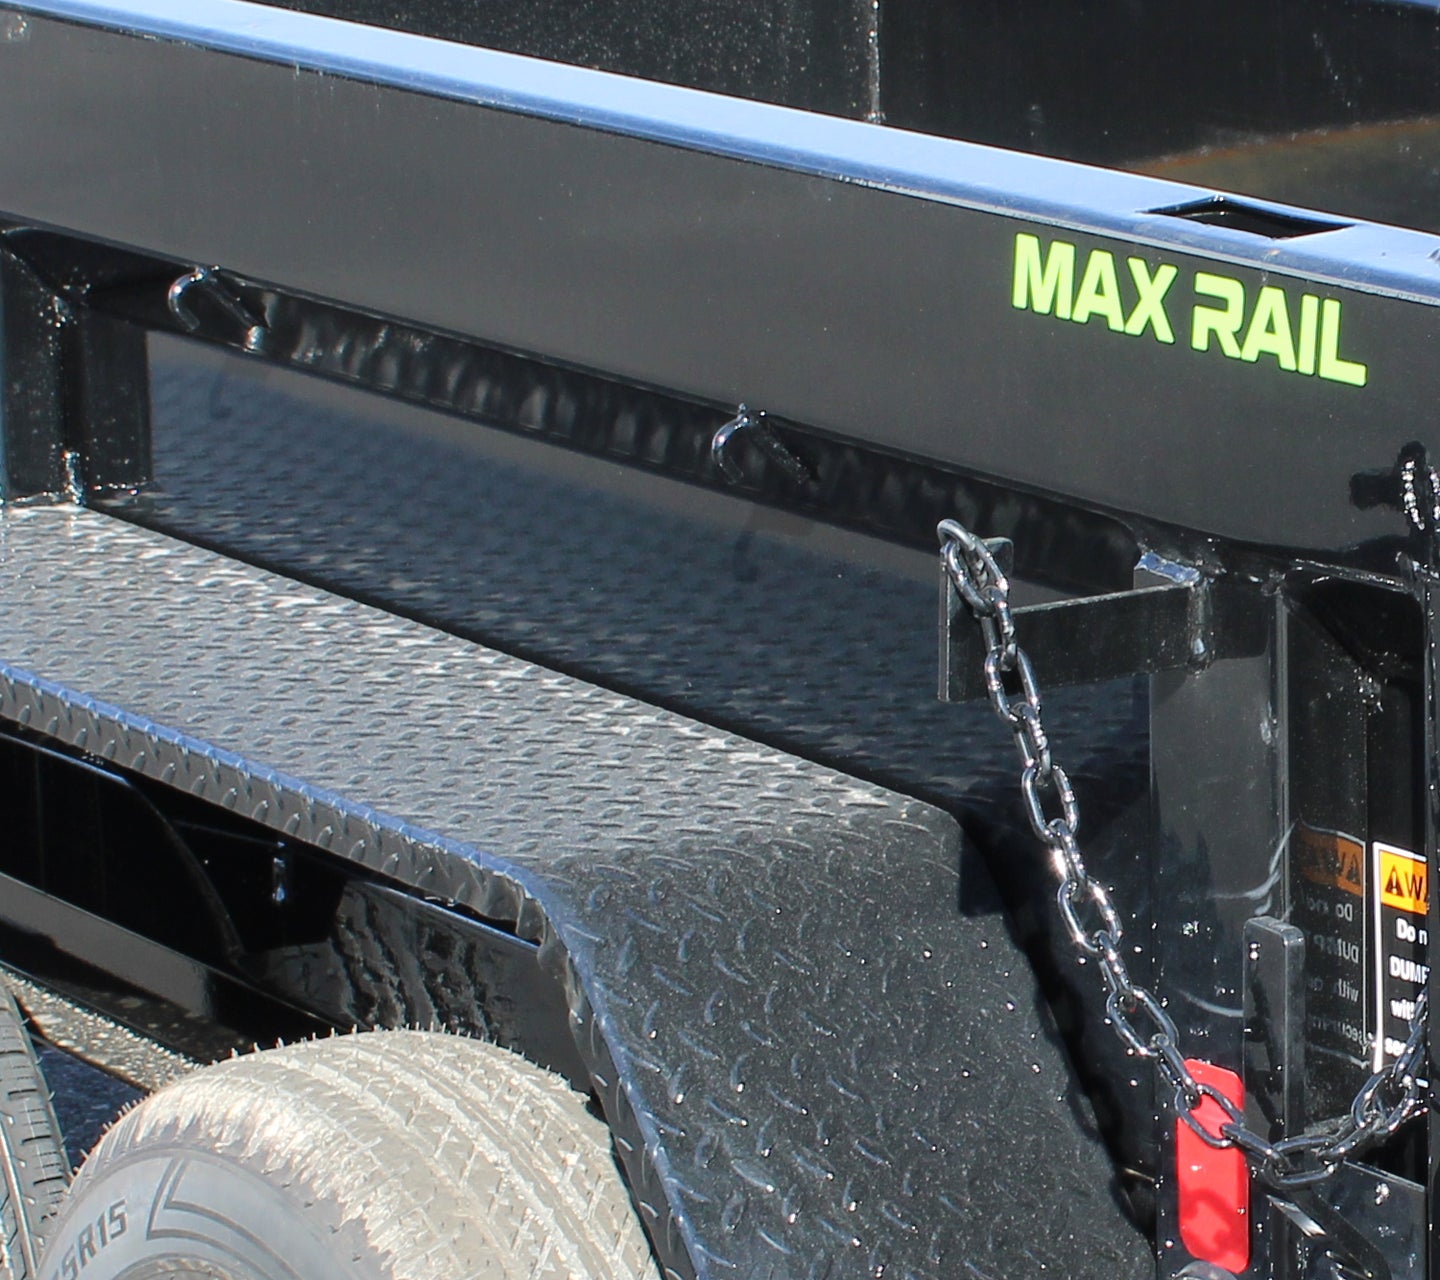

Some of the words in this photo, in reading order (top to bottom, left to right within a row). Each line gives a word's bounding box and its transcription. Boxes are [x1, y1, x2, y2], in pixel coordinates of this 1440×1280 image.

[1011, 232, 1180, 345] MAX
[1191, 271, 1369, 387] RAIL
[1403, 870, 1429, 900] W
[1397, 918, 1415, 939] Do
